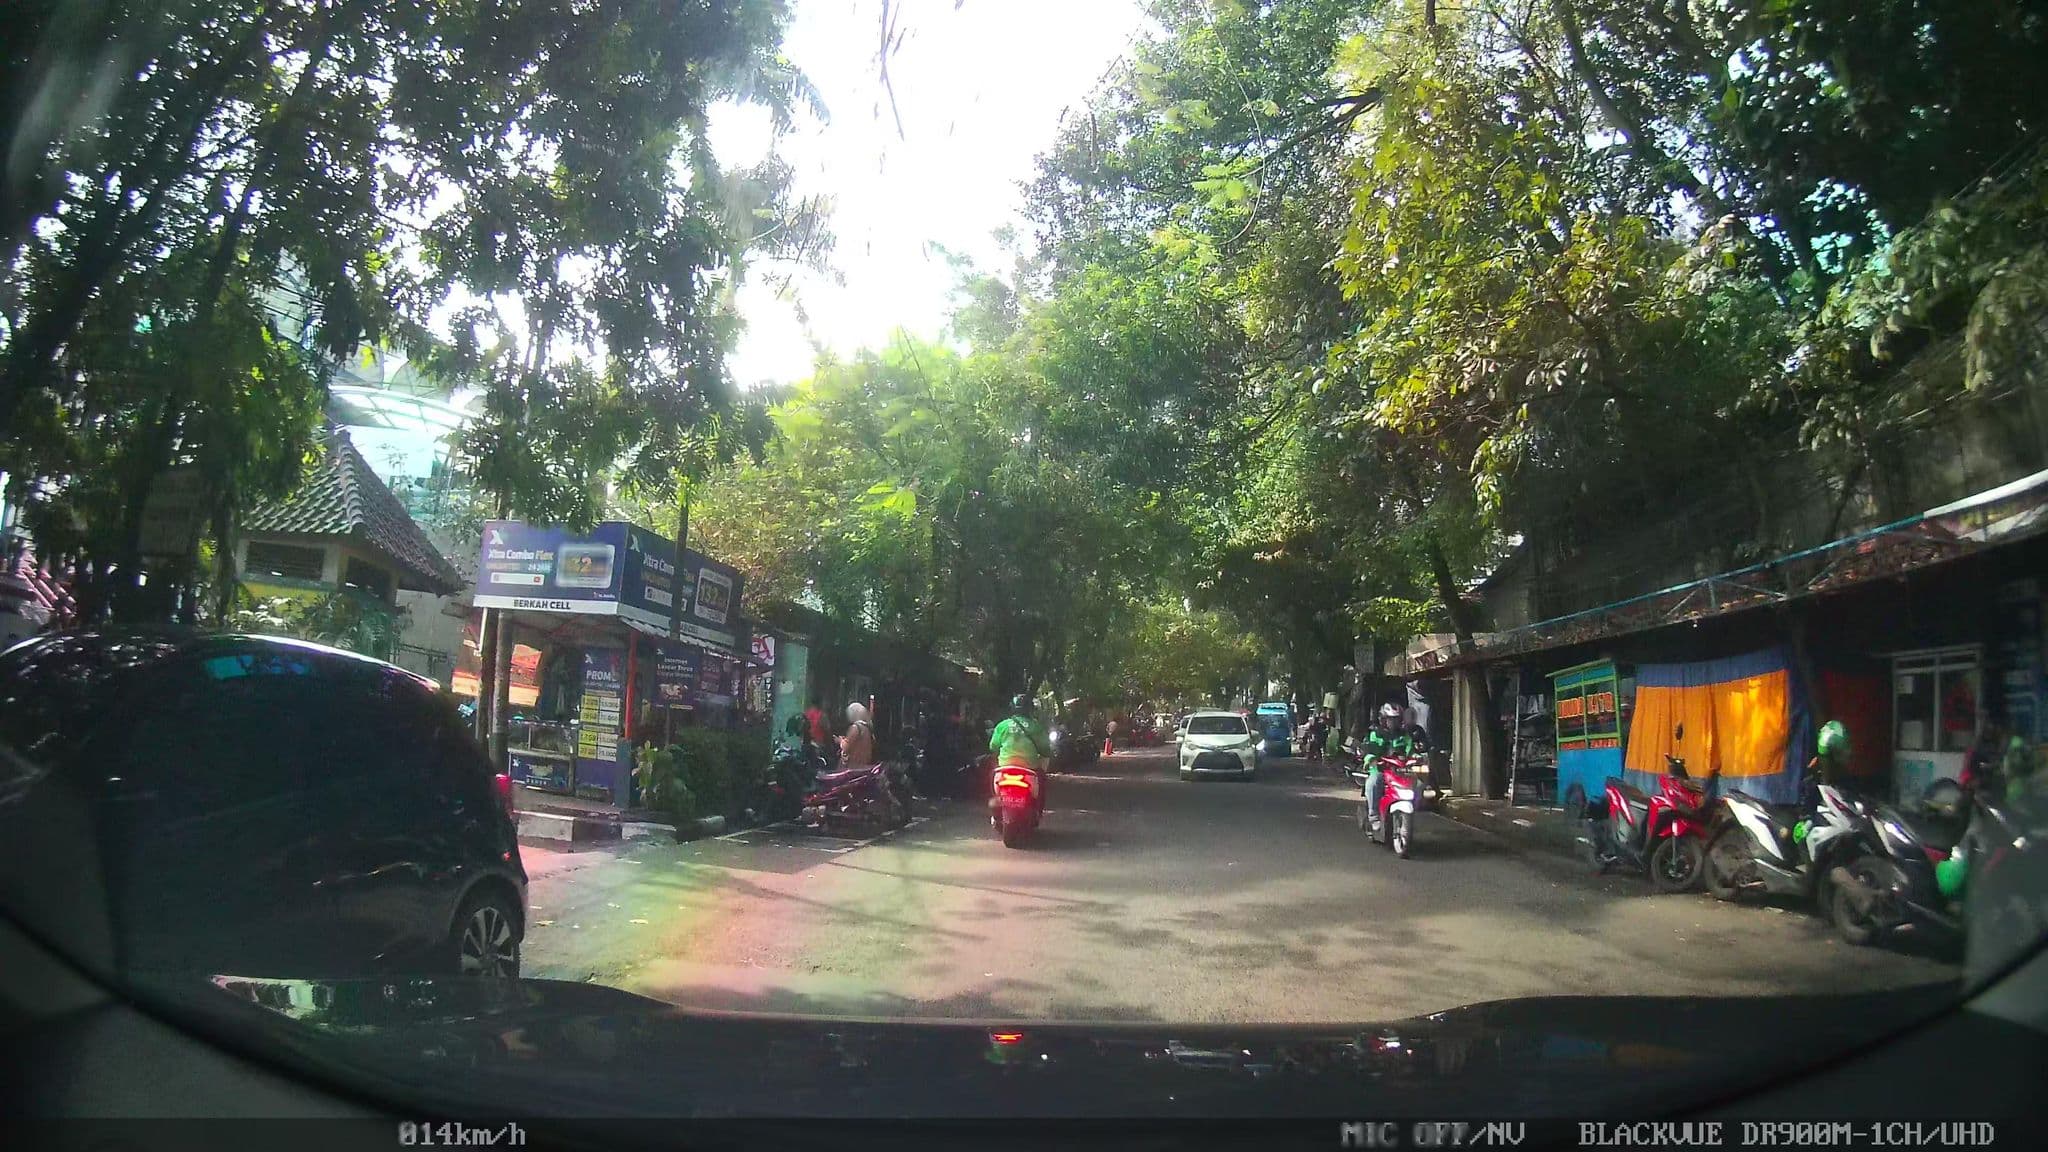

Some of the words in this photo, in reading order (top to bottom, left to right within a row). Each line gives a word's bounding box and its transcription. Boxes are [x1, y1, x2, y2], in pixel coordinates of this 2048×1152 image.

[506, 549, 534, 560] Combo
[513, 599, 548, 609] BERKAH
[549, 601, 571, 610] CELL
